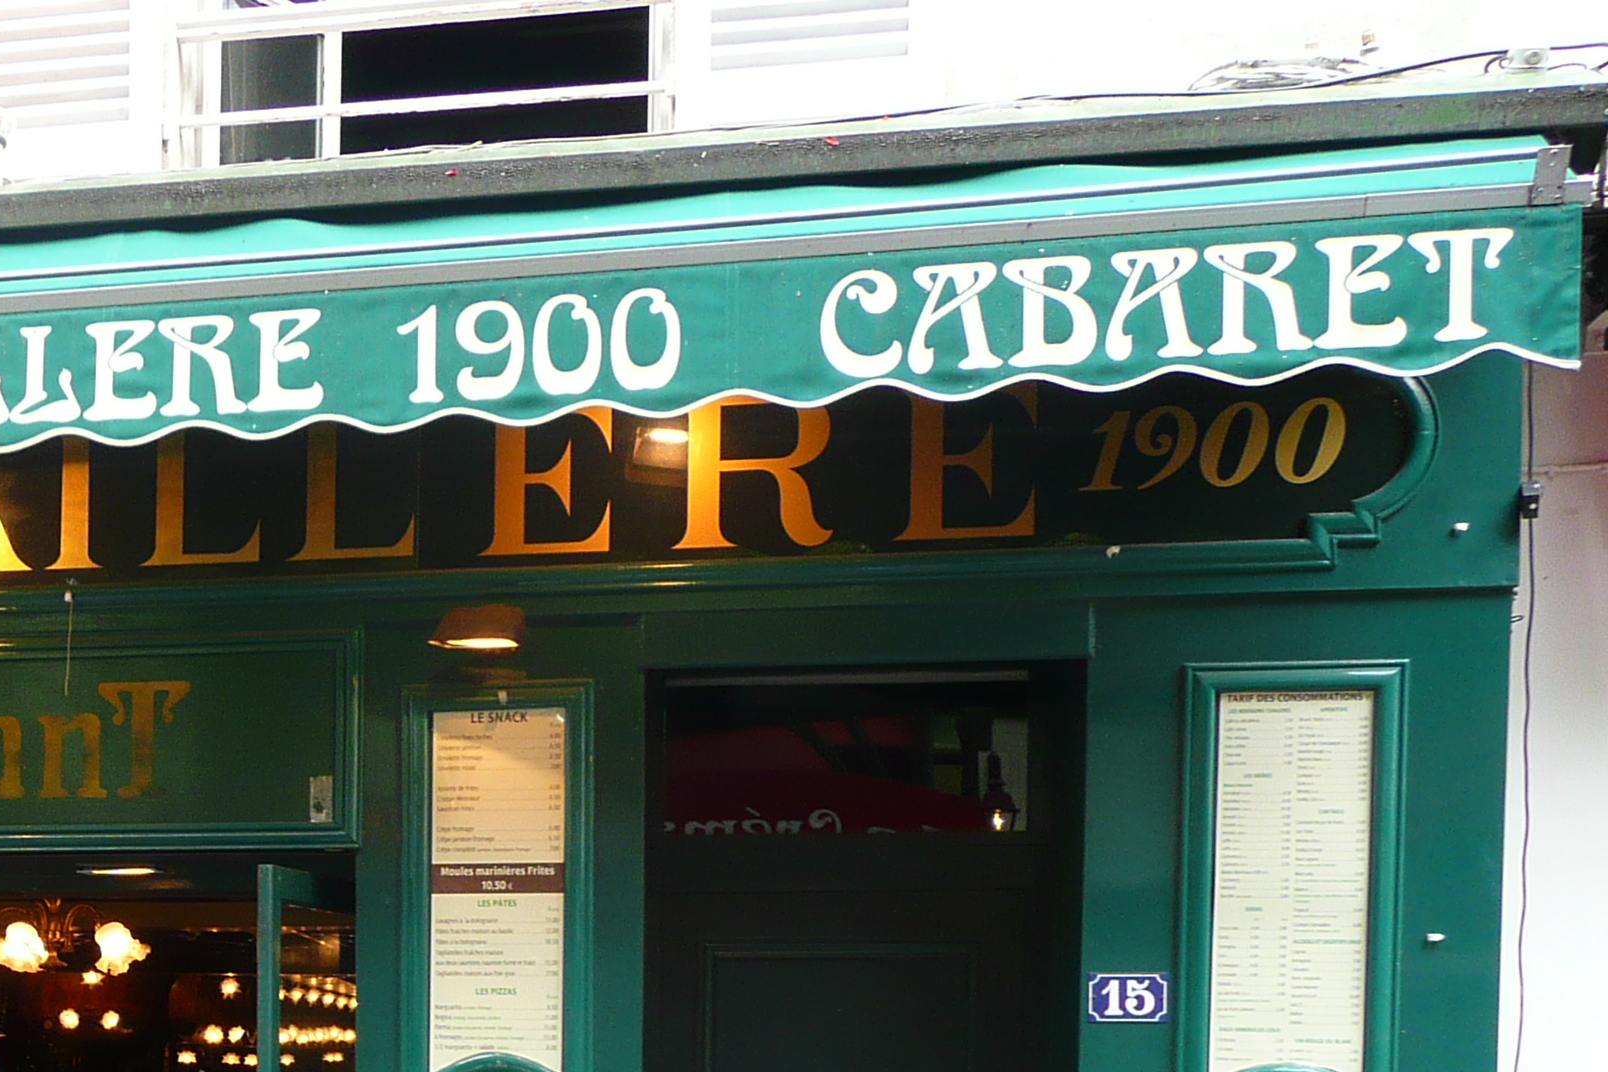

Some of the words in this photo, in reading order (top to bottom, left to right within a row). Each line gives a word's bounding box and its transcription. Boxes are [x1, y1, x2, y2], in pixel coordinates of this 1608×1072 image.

[397, 287, 682, 405] 1900
[819, 227, 1514, 379] CABARET
[1078, 396, 1347, 491] 1900
[470, 712, 485, 724] LE
[487, 711, 529, 723] SNACK
[440, 866, 474, 876] Moules
[527, 865, 556, 876] Frites
[1101, 979, 1156, 1016] 15
